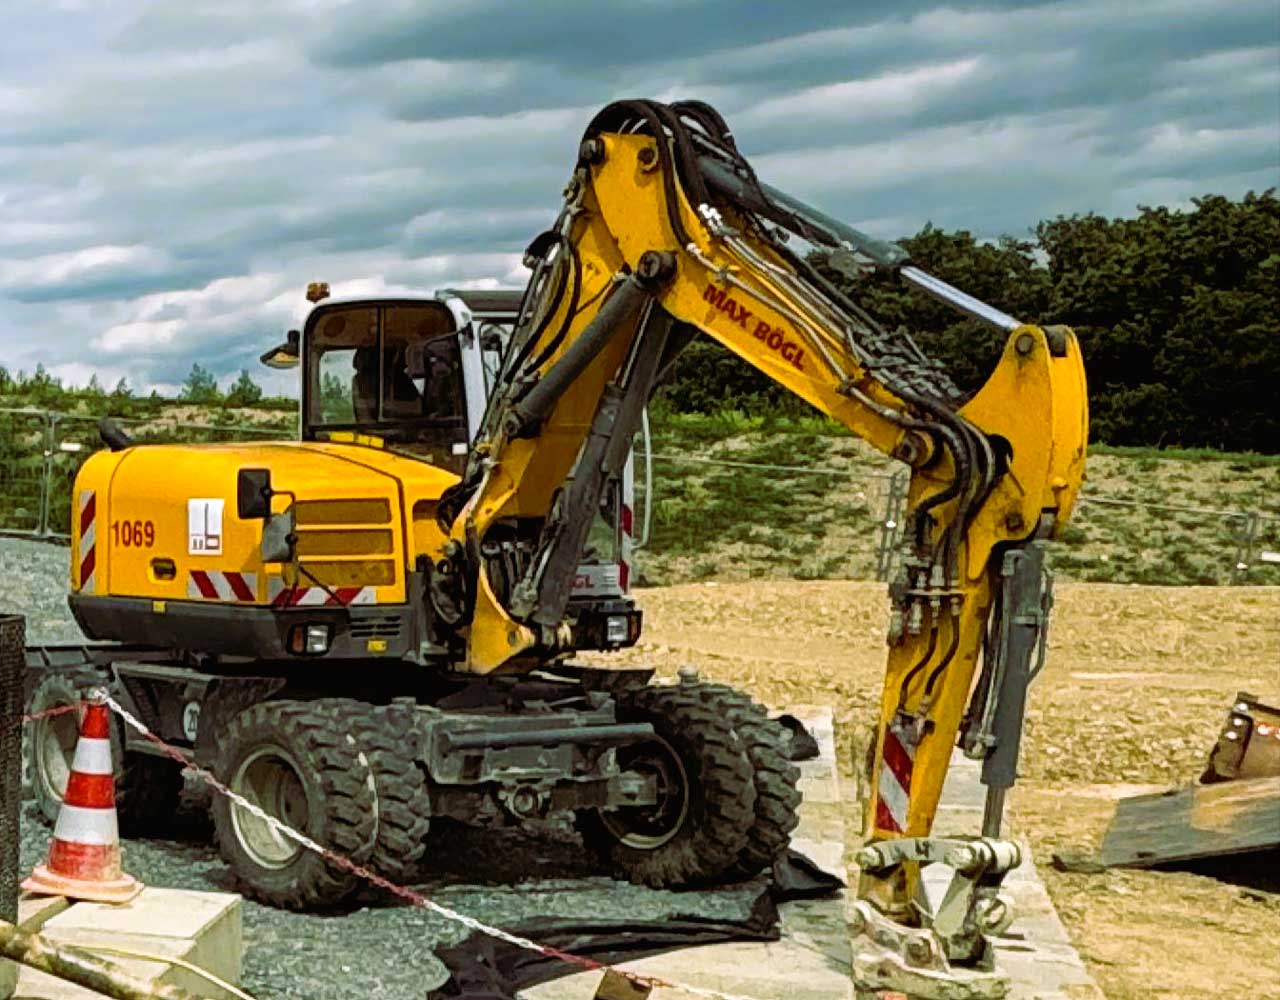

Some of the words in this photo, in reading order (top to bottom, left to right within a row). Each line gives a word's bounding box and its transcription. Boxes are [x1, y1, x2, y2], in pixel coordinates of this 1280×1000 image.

[702, 283, 753, 329] MAX
[752, 320, 805, 371] BÖGL
[111, 520, 155, 548] 1069
